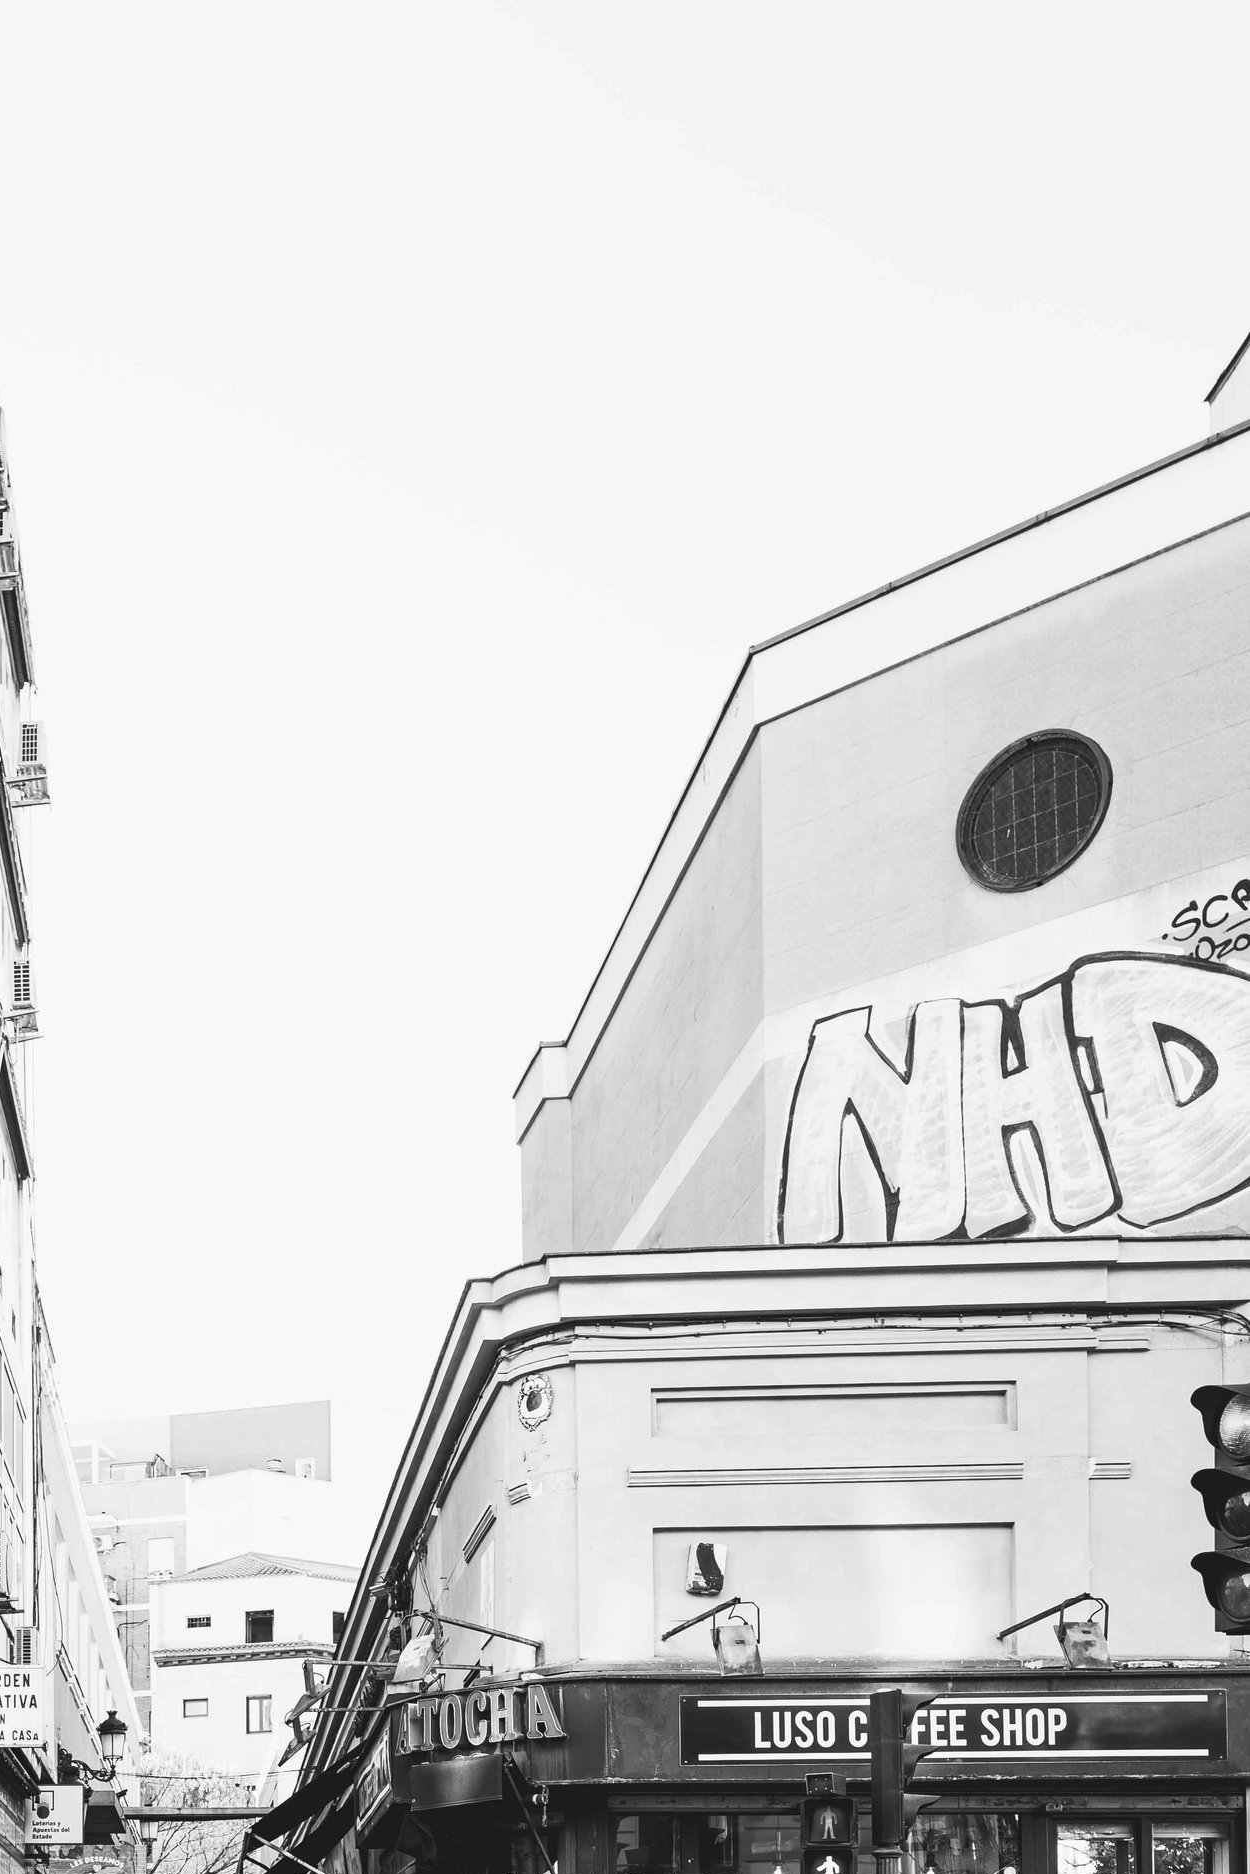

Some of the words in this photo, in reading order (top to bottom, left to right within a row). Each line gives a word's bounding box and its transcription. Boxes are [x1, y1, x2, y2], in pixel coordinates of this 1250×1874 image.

[395, 1684, 568, 1756] ATOCHA
[754, 1710, 836, 1749] LUSO
[848, 1708, 968, 1748] CFEE
[980, 1707, 1068, 1747] SHOP
[69, 1858, 84, 1869] LES
[85, 1856, 125, 1868] DESEAMOS
